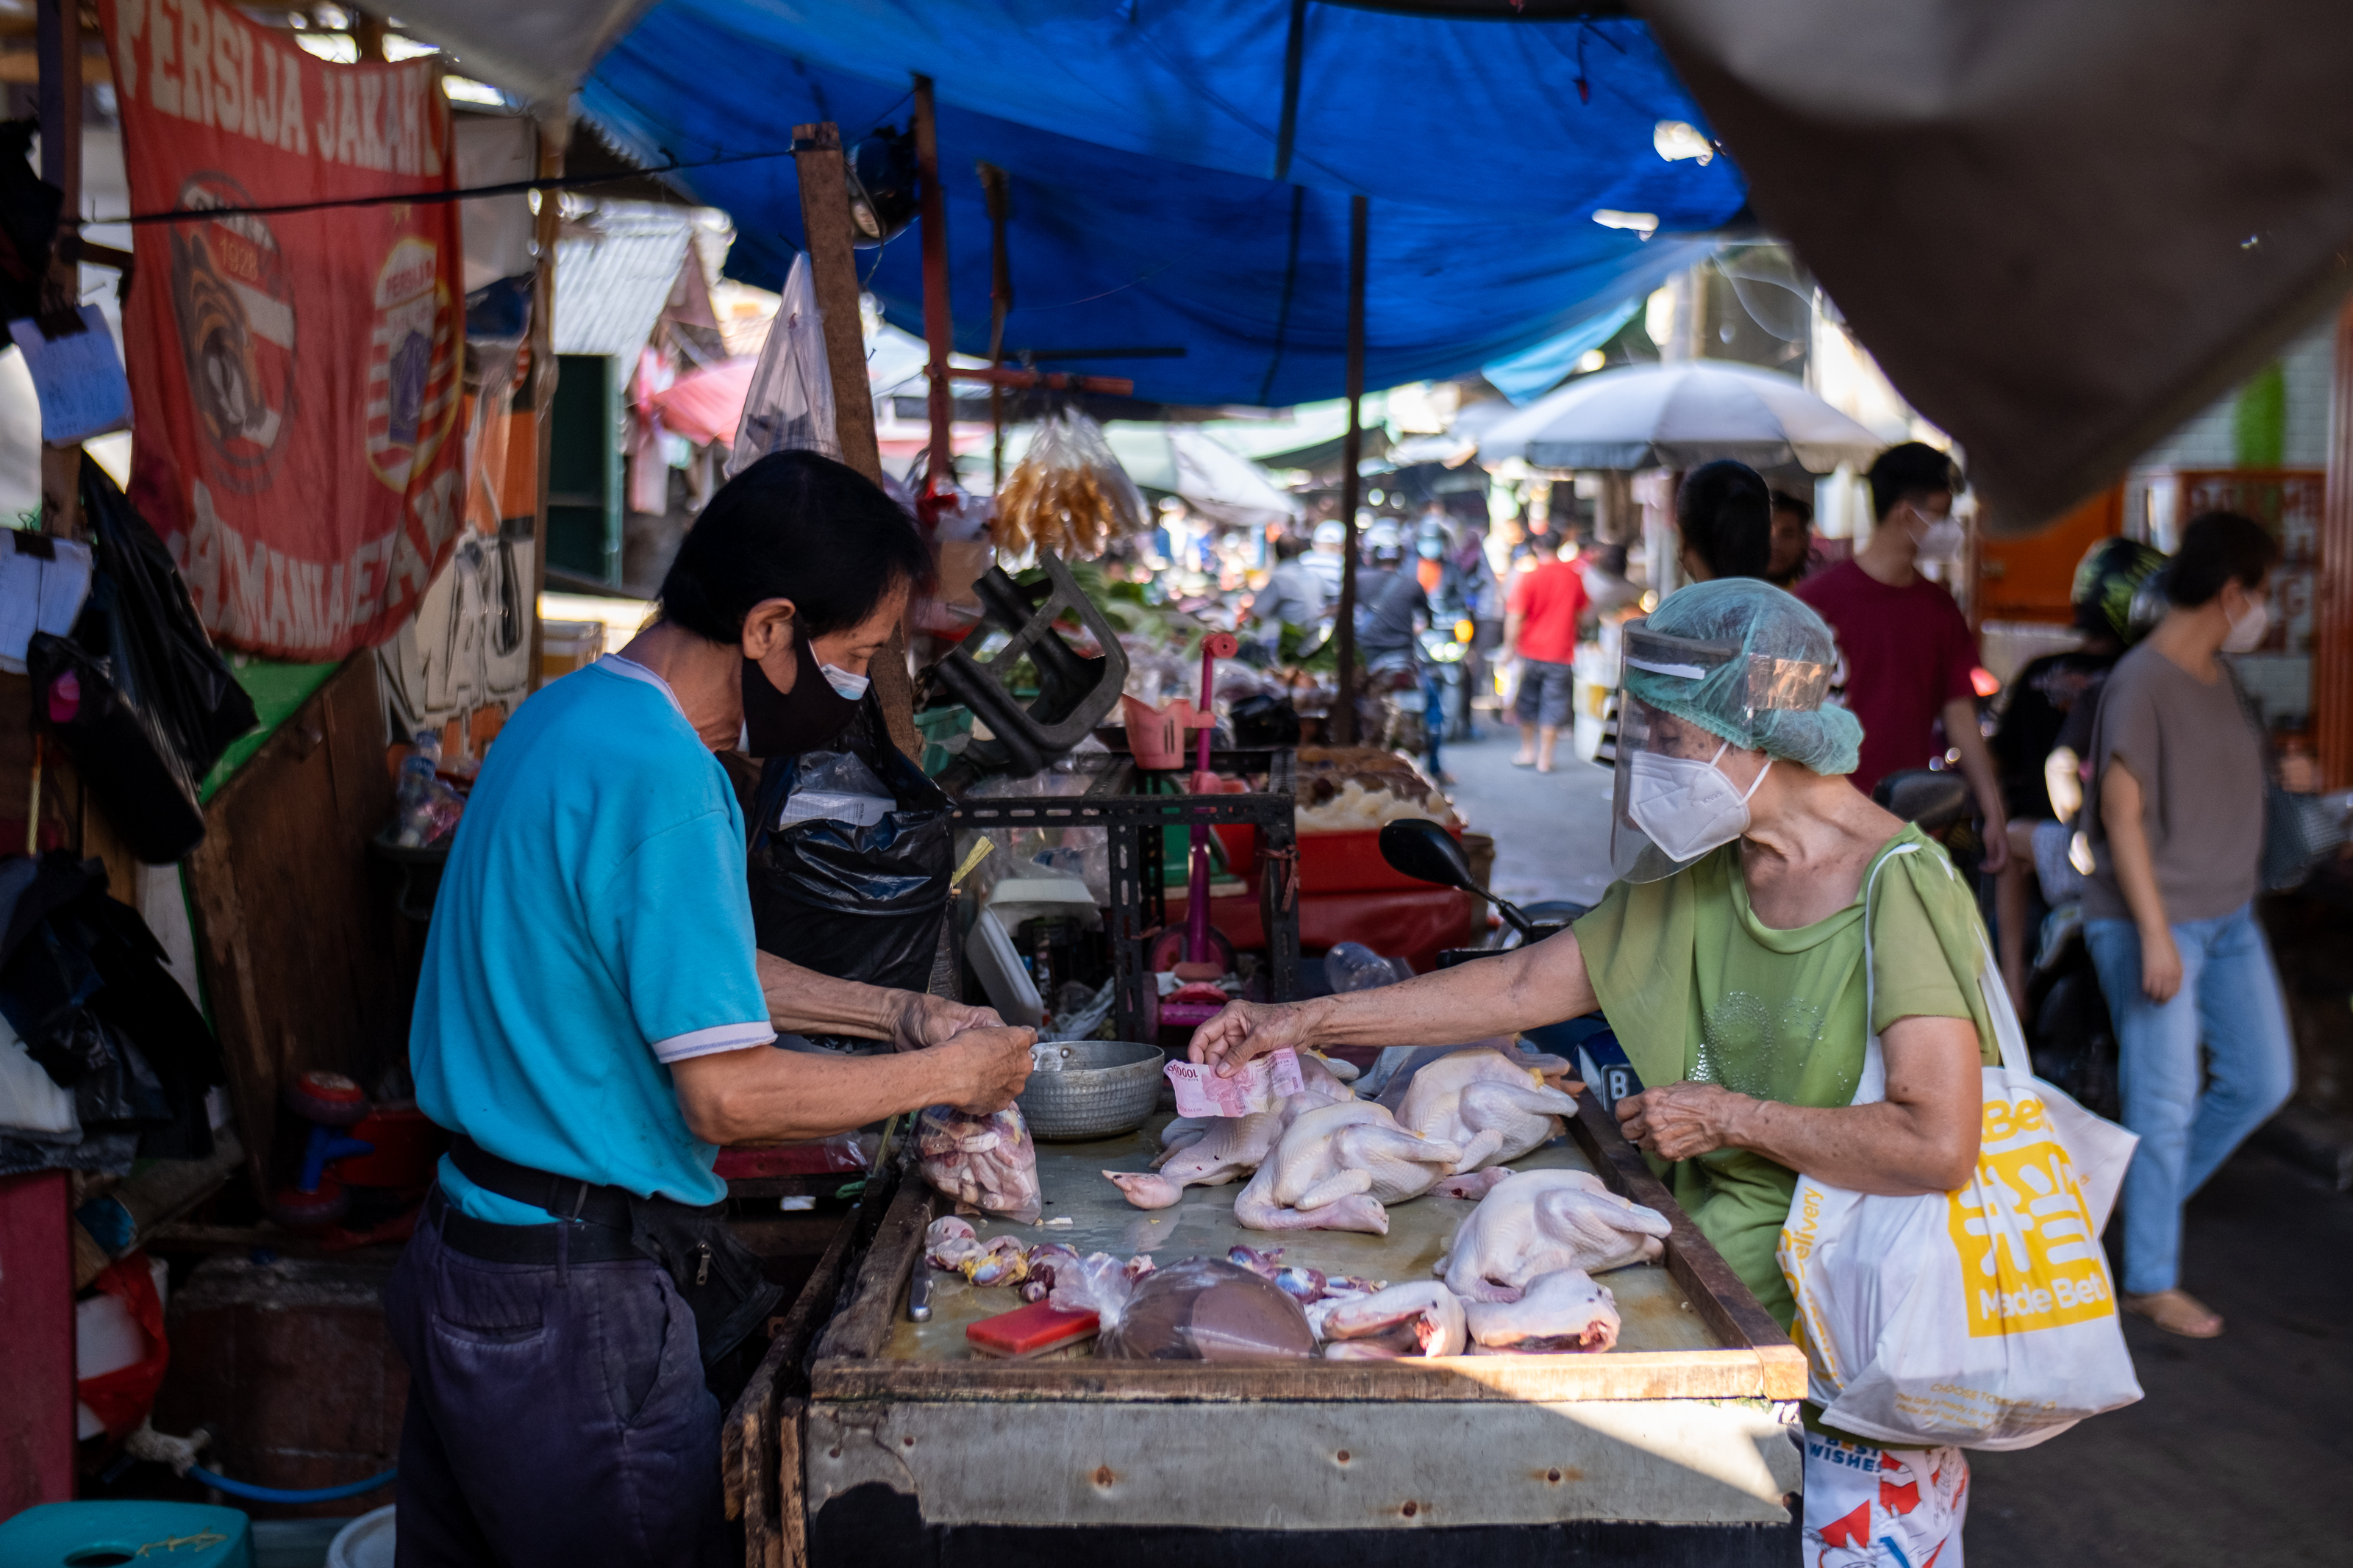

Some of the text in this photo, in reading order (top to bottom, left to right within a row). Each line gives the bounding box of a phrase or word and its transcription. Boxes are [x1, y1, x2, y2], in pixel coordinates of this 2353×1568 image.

[116, 0, 308, 157] PERSIJA
[1701, 790, 1723, 805] KN95
[1609, 1070, 1627, 1100] B
[1979, 1283, 2053, 1320] Made
[1930, 1383, 1979, 1400] CHOOSE
